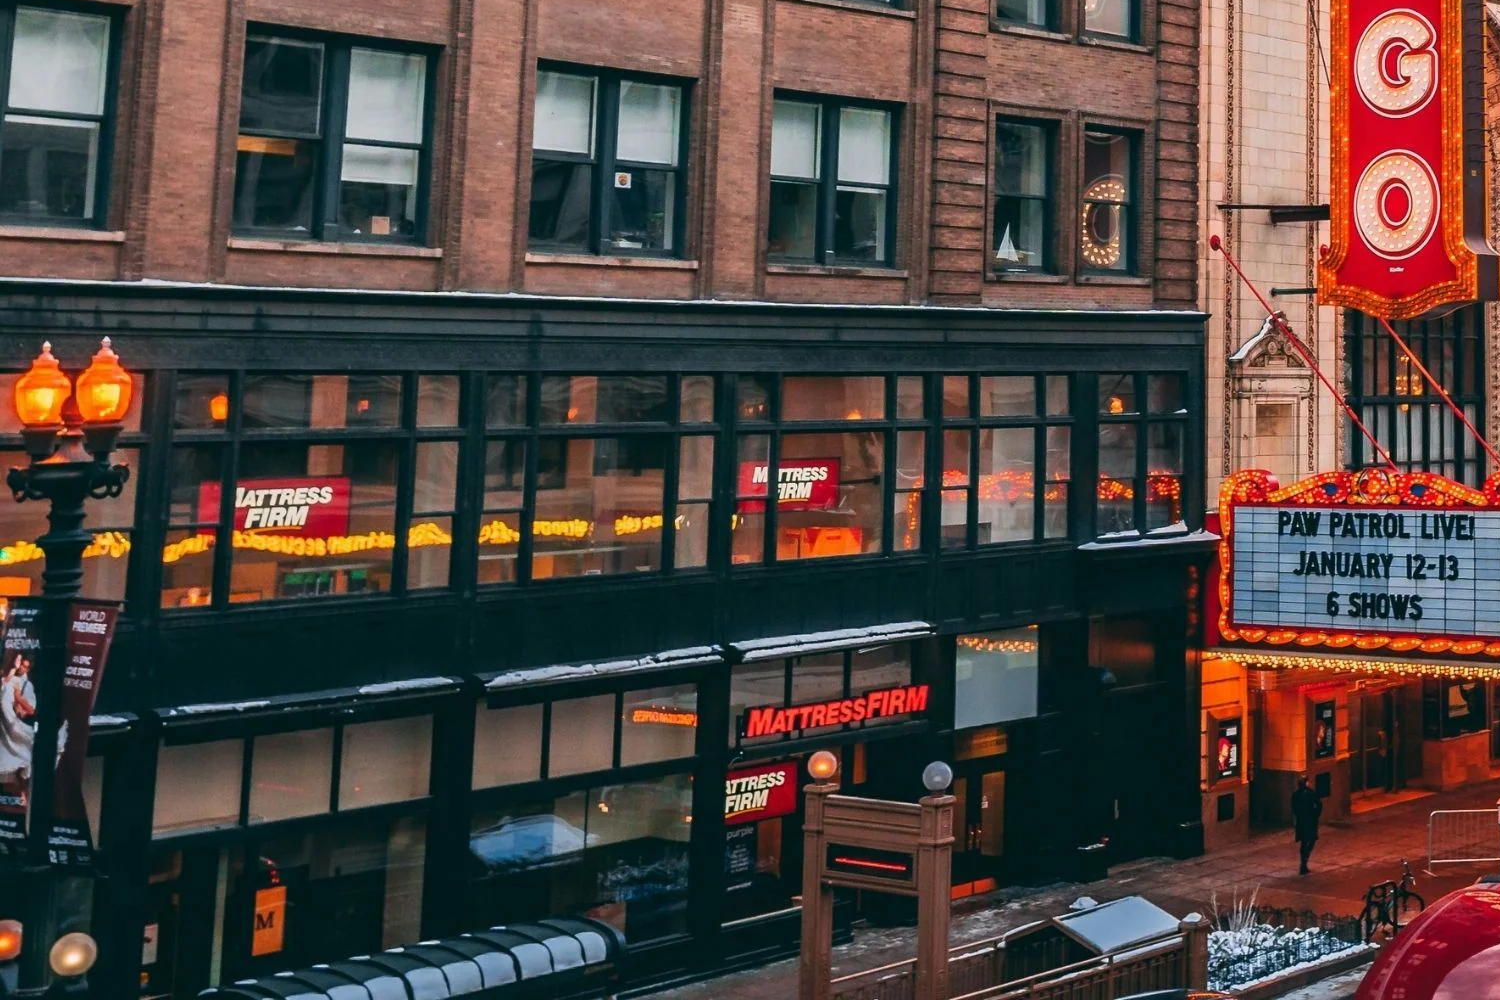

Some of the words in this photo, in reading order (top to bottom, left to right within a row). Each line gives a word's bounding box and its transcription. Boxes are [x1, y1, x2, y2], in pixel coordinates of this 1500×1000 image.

[752, 466, 828, 484] MTTRESS
[778, 482, 812, 500] IRM
[244, 505, 309, 529] FIRM
[1278, 510, 1321, 537] PAW
[1329, 512, 1410, 539] PATROL
[1421, 514, 1475, 540] LIVE!
[1293, 550, 1393, 579] JANUARY
[1407, 553, 1459, 581] 12-13
[1326, 591, 1339, 616] 6
[1348, 592, 1423, 621] SHOWS
[725, 790, 770, 814] FIRM
